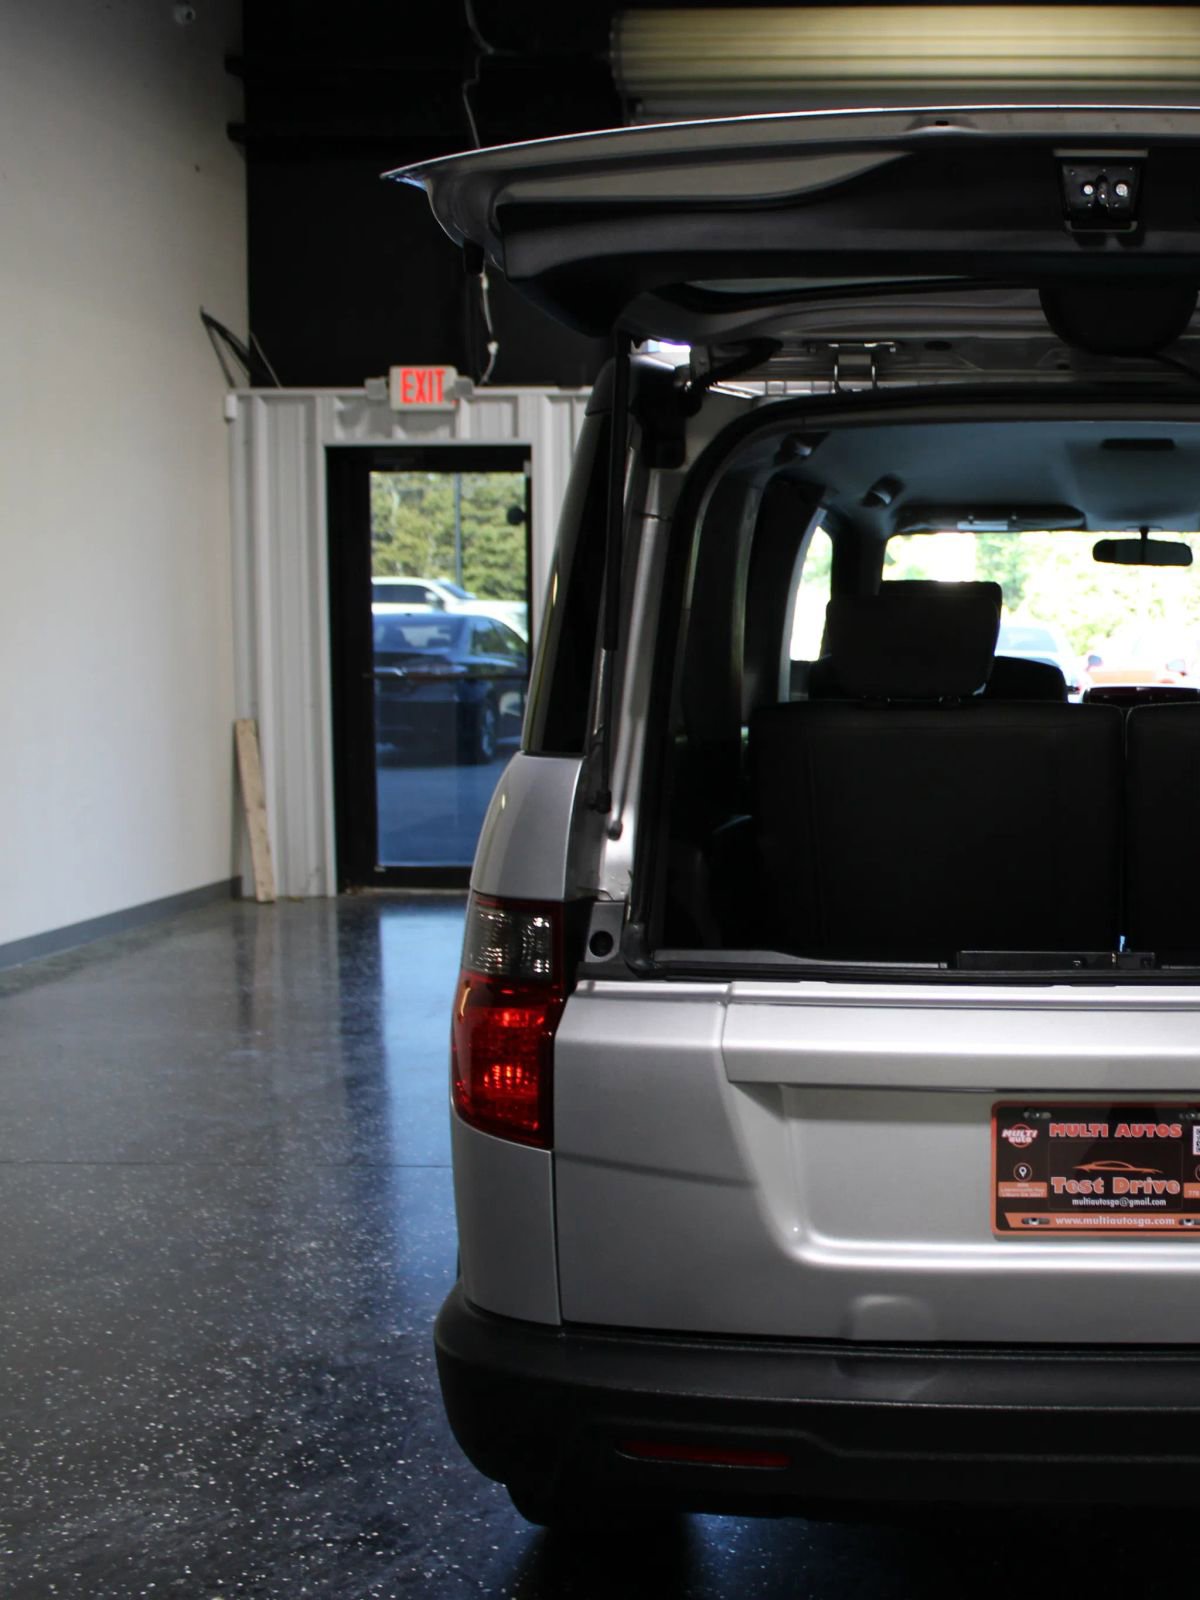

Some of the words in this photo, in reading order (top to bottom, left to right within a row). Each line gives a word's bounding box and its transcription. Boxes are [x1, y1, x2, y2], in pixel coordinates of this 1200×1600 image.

[401, 368, 445, 404] EXIT
[1001, 1128, 1038, 1138] MULTI
[1049, 1123, 1109, 1137] MULTI
[1114, 1123, 1182, 1137] AUTOS
[1051, 1176, 1104, 1194] Test
[1112, 1176, 1180, 1194] Drive
